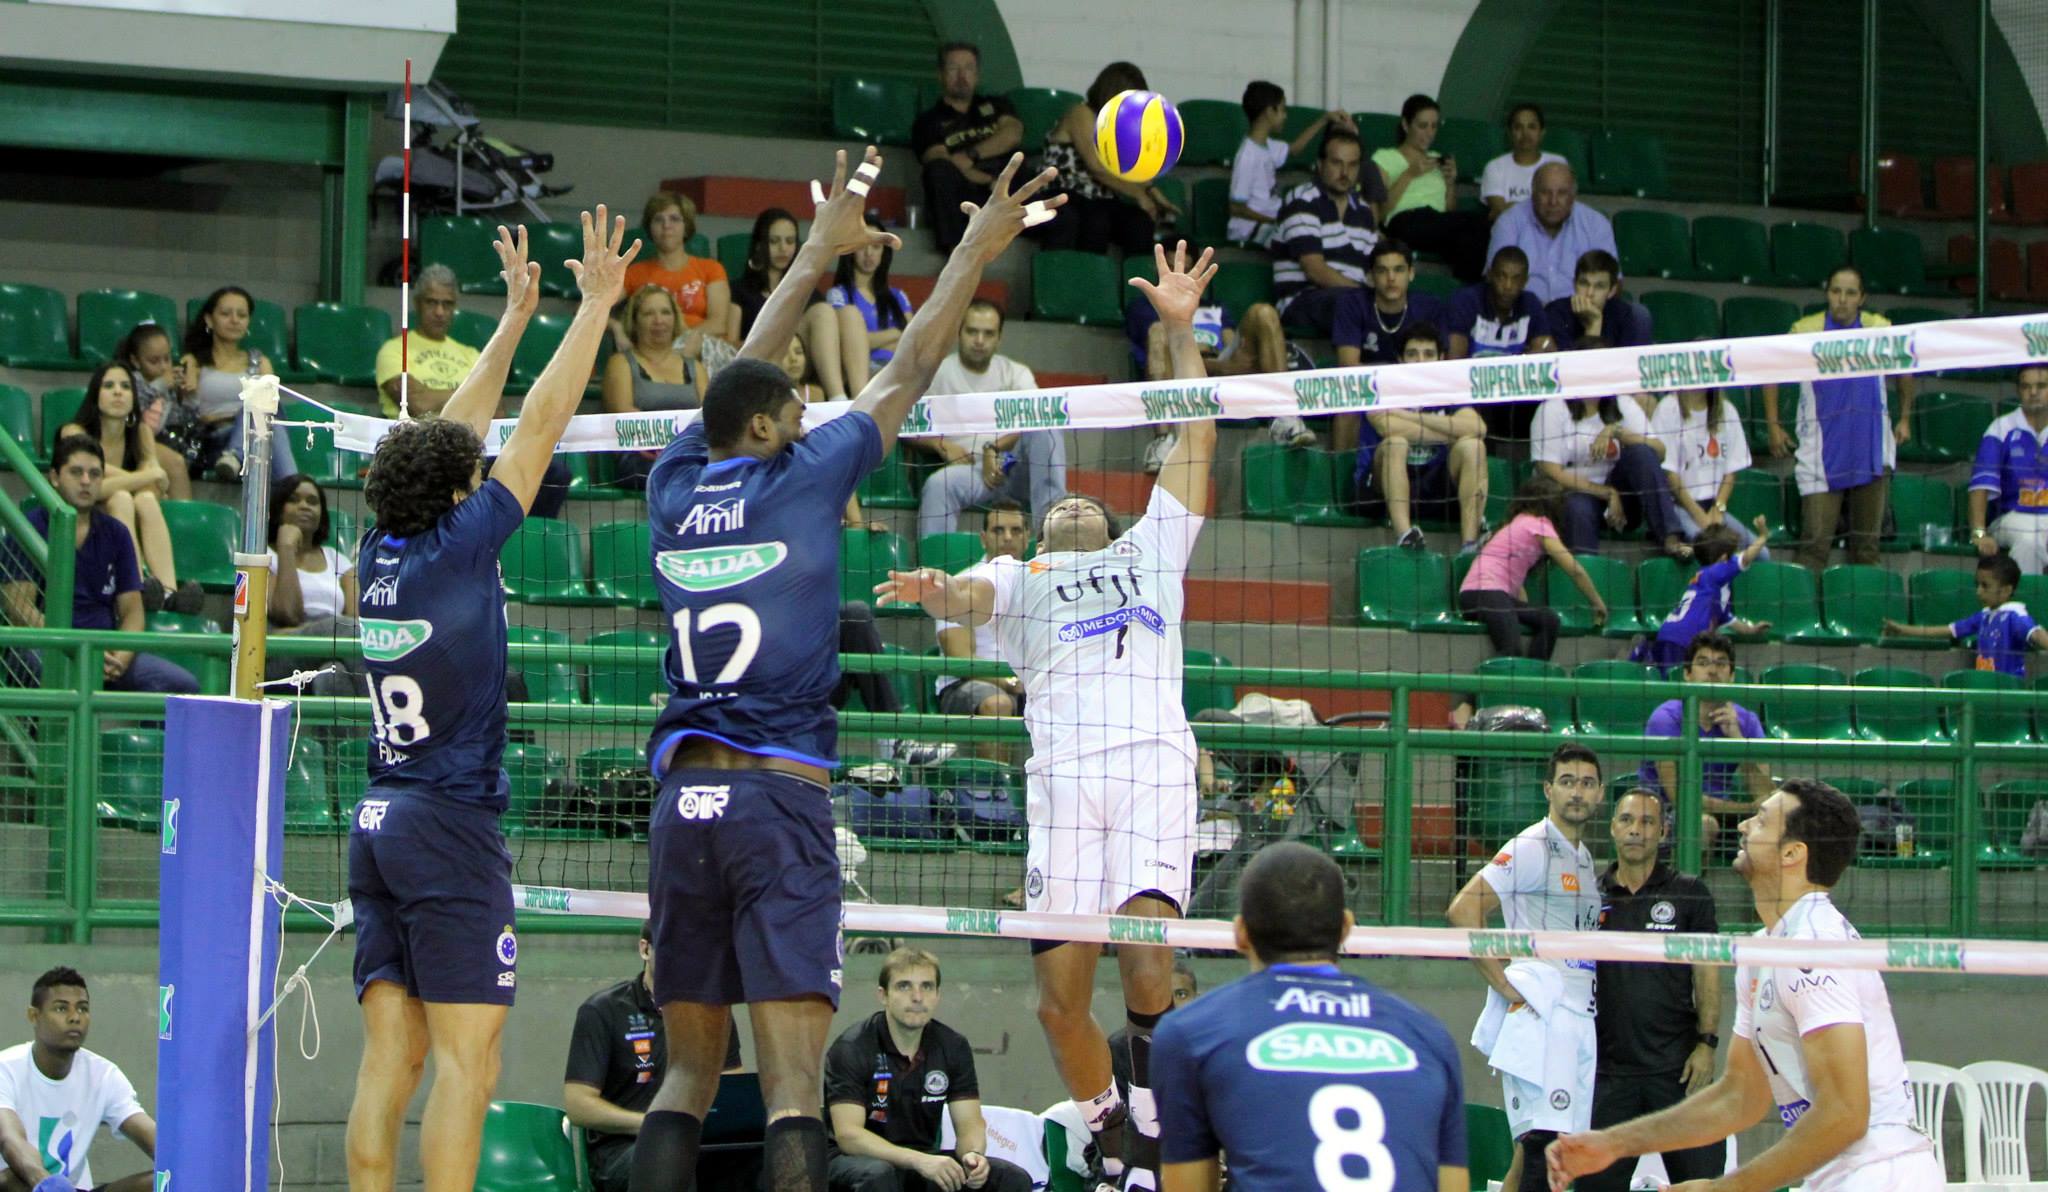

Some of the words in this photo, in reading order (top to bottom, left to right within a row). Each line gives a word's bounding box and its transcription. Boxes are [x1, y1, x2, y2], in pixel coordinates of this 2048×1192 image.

[1639, 350, 1729, 389] SUPERLIGA
[1811, 335, 1912, 374] SUPERLIGA
[1295, 374, 1375, 410] SUPERLIGA
[1469, 361, 1557, 399] SUPERLIGA
[993, 395, 1065, 429] SUPERLIGA
[1140, 385, 1219, 421] SUPERLIGA
[615, 418, 674, 447] SUPERLIGA
[675, 498, 745, 536] Amil
[667, 550, 765, 578] SADA
[362, 575, 398, 606] Amil
[1789, 975, 1838, 993] VIVA
[1270, 987, 1371, 1018] Amil
[1268, 1033, 1399, 1064] SADA
[1308, 1084, 1397, 1192] 8
